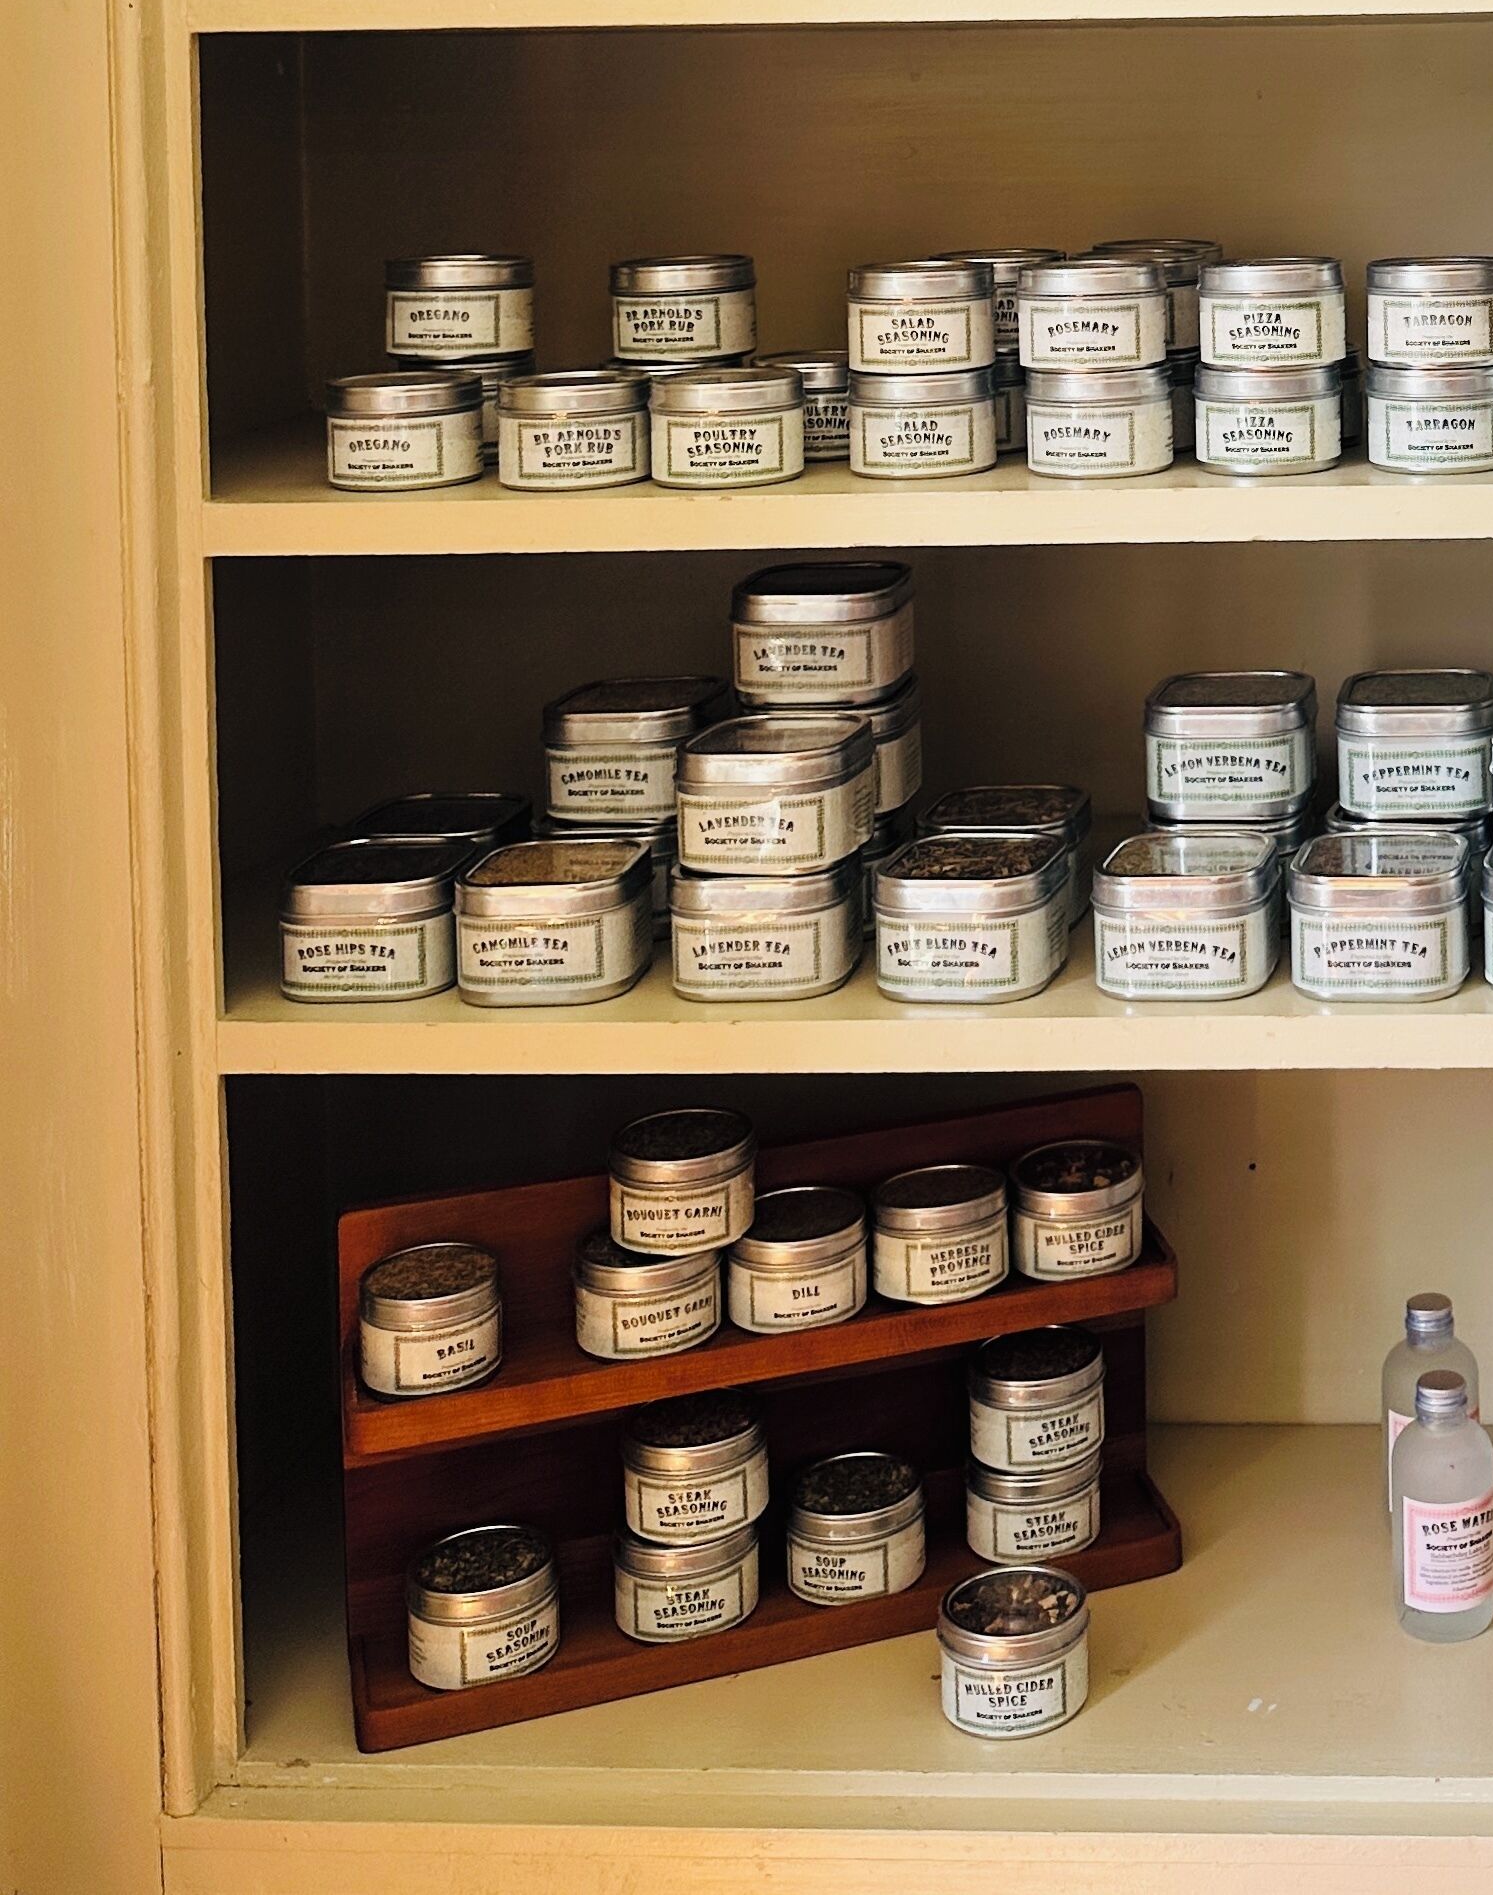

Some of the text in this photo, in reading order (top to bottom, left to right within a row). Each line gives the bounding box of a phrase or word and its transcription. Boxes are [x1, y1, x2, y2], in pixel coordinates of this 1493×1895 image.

[410, 310, 469, 323] OREGANO
[643, 309, 703, 320] ARNOLD'S
[1244, 313, 1282, 324] PIZZA
[1403, 314, 1472, 328] TARRAGON
[633, 321, 695, 333] PORK RUB
[892, 318, 935, 329] SALAD
[1047, 321, 1119, 337] ROSEMARY
[878, 331, 949, 345] SEASONING
[1229, 325, 1301, 340] SEASONING
[803, 405, 847, 416] ULTRY
[896, 420, 938, 432] SALAD
[1406, 419, 1475, 432] TARRAGON
[558, 429, 621, 442] ARNOLD'S
[694, 429, 757, 441] POULTRY
[880, 433, 952, 448] SEASONING
[1044, 427, 1111, 442] ROSEMARY
[1222, 429, 1293, 443] SEASONING
[349, 439, 410, 453] OREGANO
[544, 442, 614, 458] PORK RUB
[687, 443, 762, 458] SEASONING
[821, 645, 845, 659] TEA
[1164, 755, 1287, 777] LEMON VERBENA TEA
[561, 769, 648, 785] CAMOMILE TEA
[1185, 776, 1216, 784] SOCIETY
[1362, 766, 1470, 783] PEPPERMINT TEA
[699, 815, 764, 833] LAVENDER
[298, 943, 396, 960] ROSE HIPS TEA
[473, 937, 569, 954] CAMOMILE TEA
[692, 940, 790, 958] LAVENDER TEA
[926, 938, 967, 951] BLEND
[971, 941, 997, 958] TEA
[1108, 940, 1236, 963] LEMON VERBENA TEA
[1402, 941, 1428, 959] TEA
[627, 1205, 723, 1221] BOUQUET GARNI
[1045, 1224, 1126, 1246] MULLED CIDER
[931, 1245, 978, 1264] HERBES
[1069, 1241, 1105, 1255] SPICE
[930, 1254, 991, 1277] PROVENCE
[792, 1286, 820, 1300] DILL
[622, 1307, 680, 1330] BOUQUET
[436, 1339, 475, 1360] BASIL
[1041, 1412, 1080, 1433] STEAK
[1029, 1422, 1090, 1448] SEASONING
[668, 1489, 712, 1504] STEAK
[656, 1500, 727, 1518] SEASONING
[1026, 1511, 1065, 1527] STEAK
[1014, 1521, 1078, 1542] SEASONING
[1422, 1521, 1457, 1536] ROSE
[816, 1556, 846, 1568] SOUP
[802, 1567, 866, 1582] SEASONING
[667, 1588, 710, 1605] STEAK
[654, 1599, 725, 1620] SEASONING
[506, 1619, 537, 1642] SOUP
[965, 1677, 1054, 1696] MULLED CIDER
[989, 1695, 1027, 1708] SPICE
